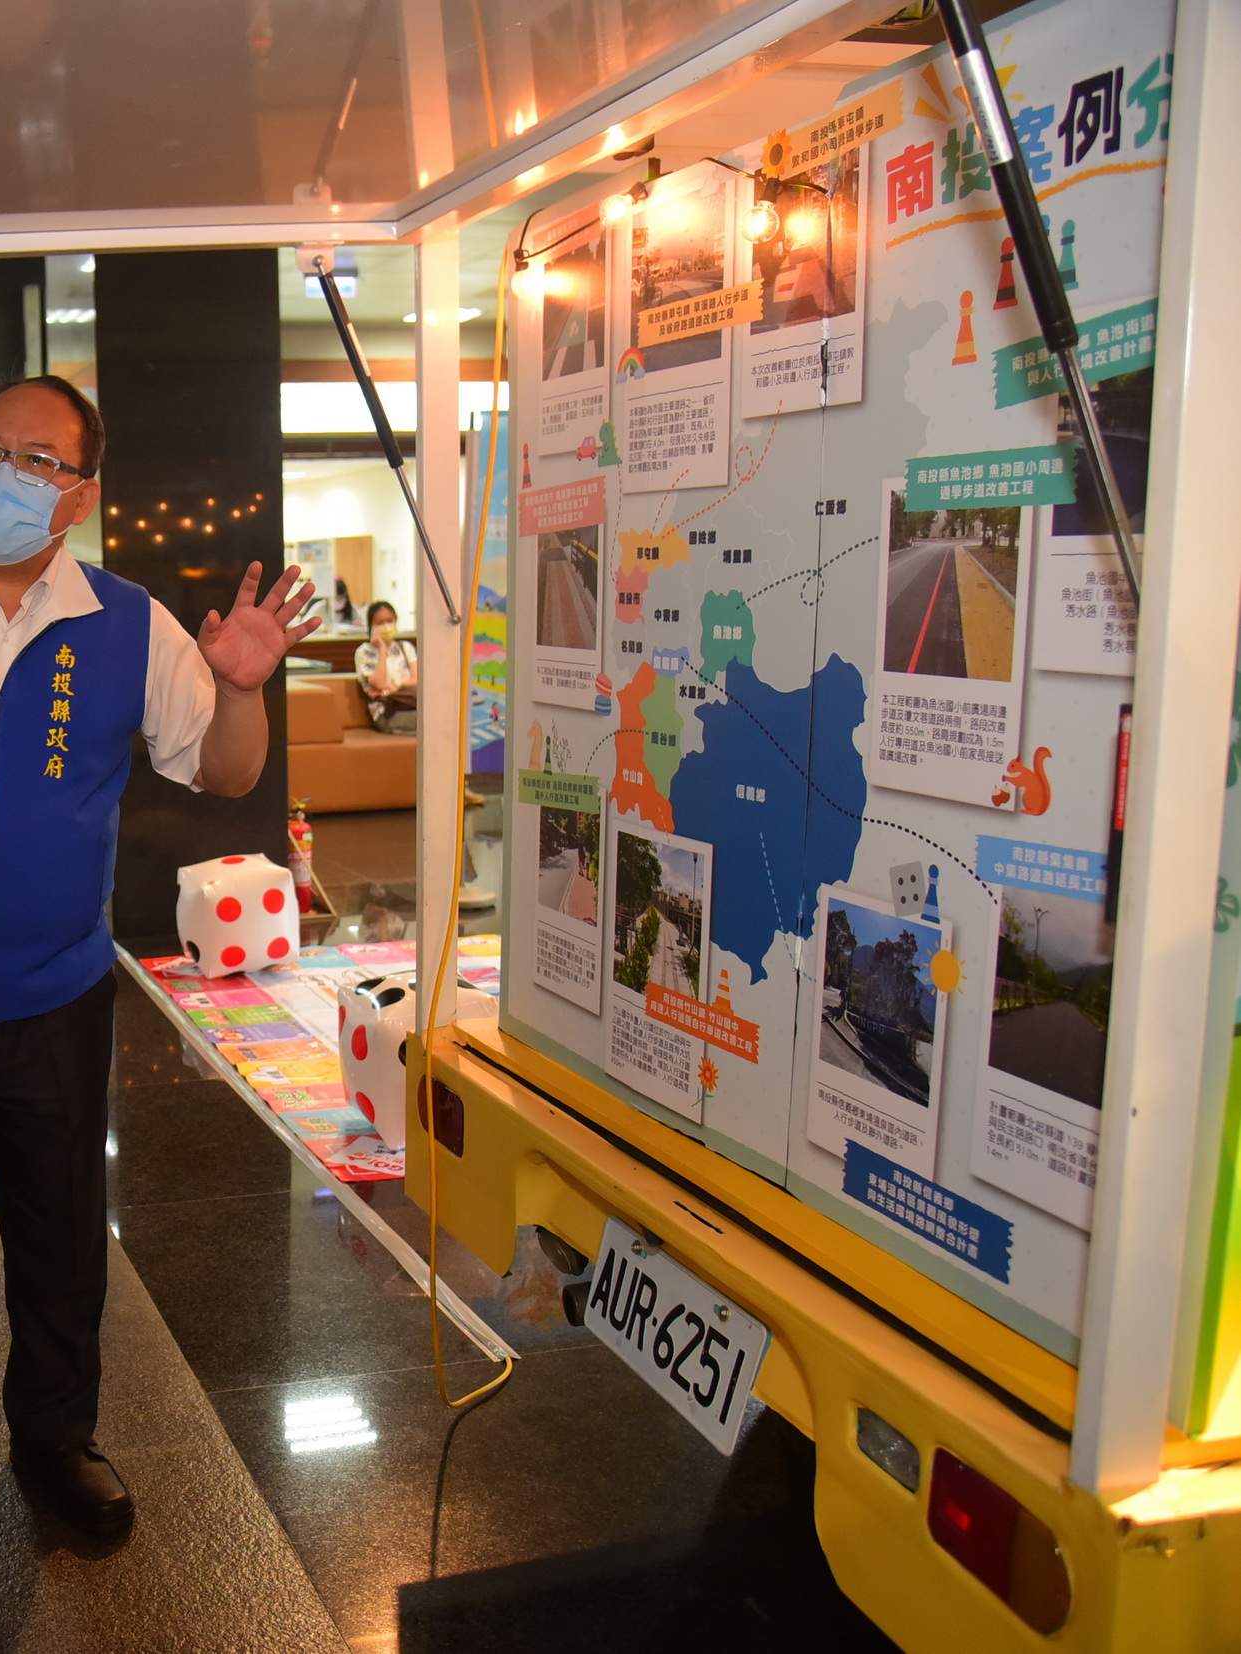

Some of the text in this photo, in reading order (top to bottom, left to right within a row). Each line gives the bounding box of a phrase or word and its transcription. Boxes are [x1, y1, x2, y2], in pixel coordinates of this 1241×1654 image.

[751, 347, 855, 376] 本次改善範圍位於南投草屯鎮敦
[1012, 334, 1091, 372] 南投縣鄉
[1027, 335, 1153, 387] 與人行境改善計畫
[917, 465, 984, 484] 南投縣魚池鄉
[814, 499, 847, 516] 仁愛鄉
[688, 530, 716, 545] 國姓鄉
[636, 547, 660, 560] 草屯鎮
[723, 549, 752, 564] 埔里鎮
[618, 592, 640, 605] 南投市
[654, 609, 680, 623] 中寮鄉
[713, 625, 743, 640] 魚池鄉
[679, 685, 706, 700] 水里鄉
[43, 644, 76, 779] 南投縣政府
[651, 731, 677, 747] 鹿谷鄉
[622, 768, 643, 786] 竹山鎮
[735, 783, 766, 803] 信義鄉
[663, 992, 739, 1032] 南投縣竹山鎮 竹山國中
[892, 1169, 955, 1212] 南投縣信義鄉
